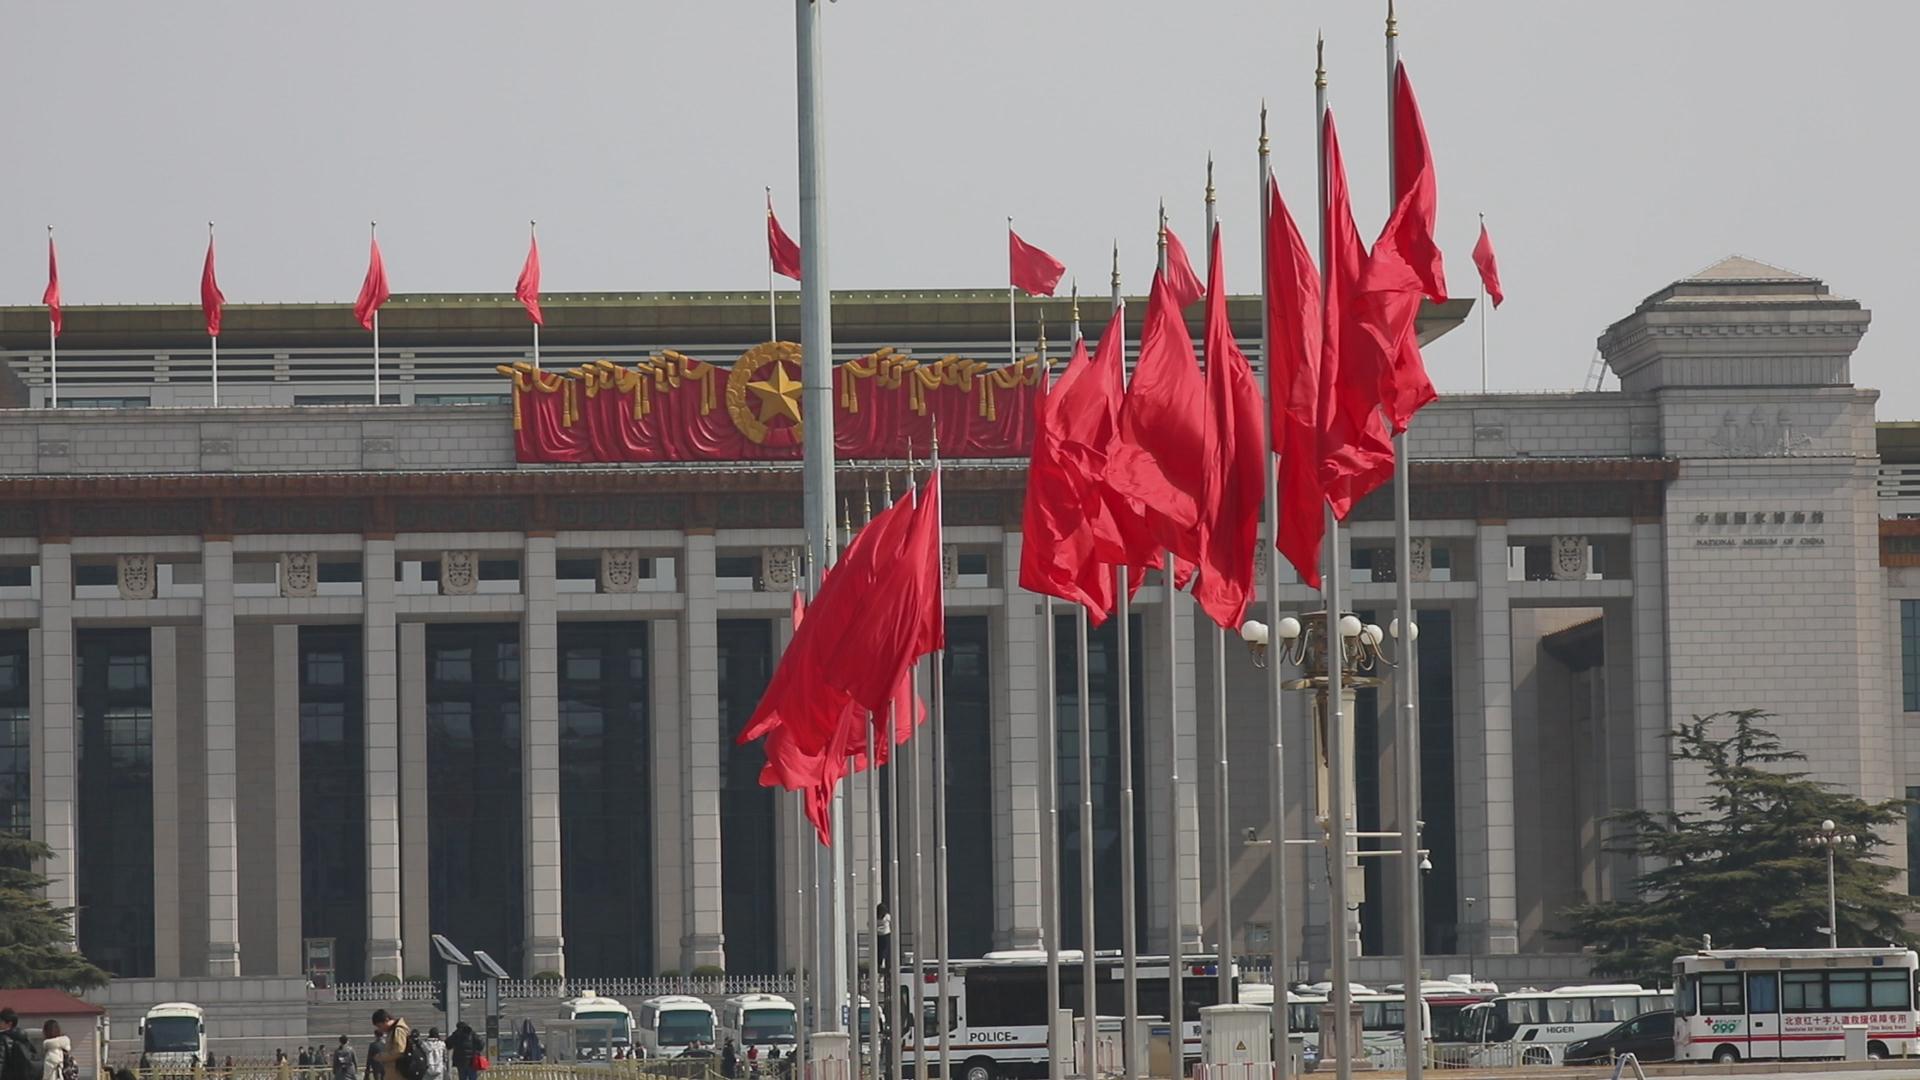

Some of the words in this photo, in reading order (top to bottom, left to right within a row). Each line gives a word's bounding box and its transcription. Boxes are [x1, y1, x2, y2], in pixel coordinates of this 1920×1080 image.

[1695, 538, 1737, 547] NATIONAL
[1743, 538, 1778, 546] MUSEUM
[1783, 537, 1794, 546] OF
[1800, 537, 1825, 546] CHINA
[1546, 1026, 1575, 1034] HIGER
[1711, 1023, 1737, 1034] 999
